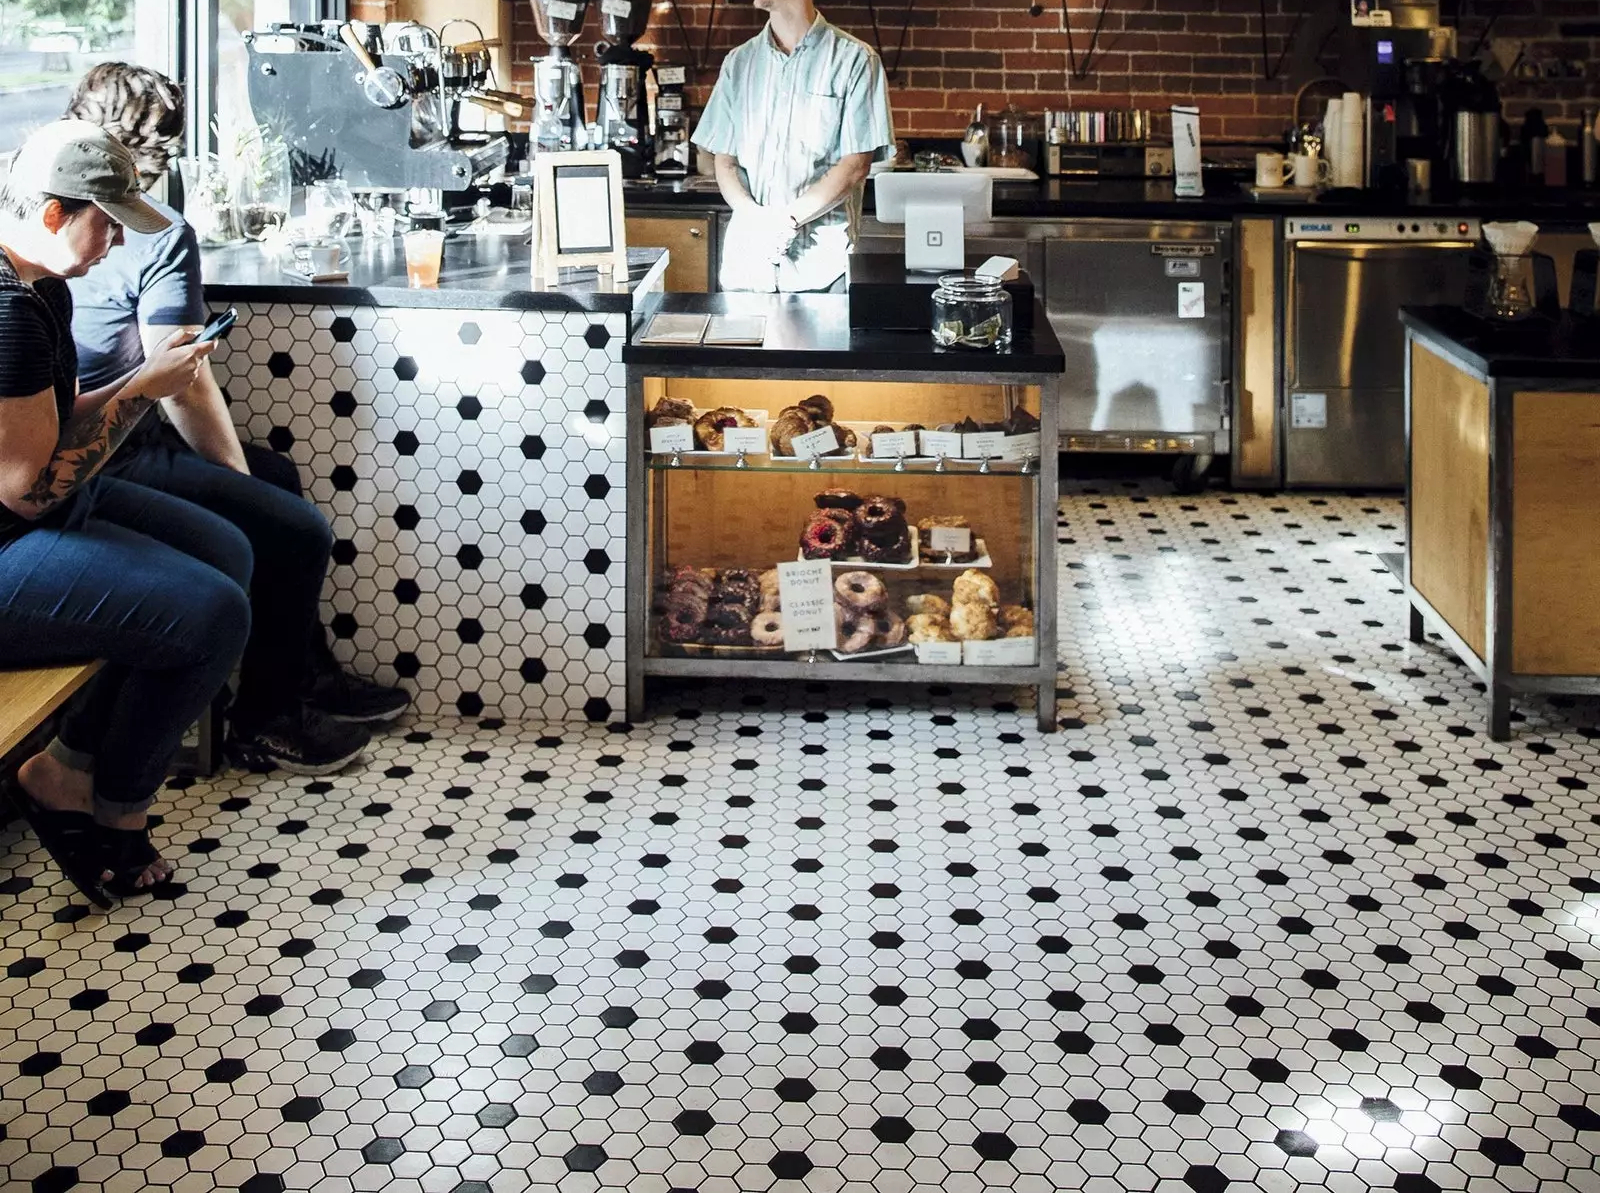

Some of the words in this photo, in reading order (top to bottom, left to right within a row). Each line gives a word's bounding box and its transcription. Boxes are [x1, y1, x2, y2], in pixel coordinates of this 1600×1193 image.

[786, 567, 822, 577] BRIOCHE
[790, 577, 820, 586] DONUT
[789, 598, 825, 608] CLASSIC
[793, 607, 822, 617] DONUT
